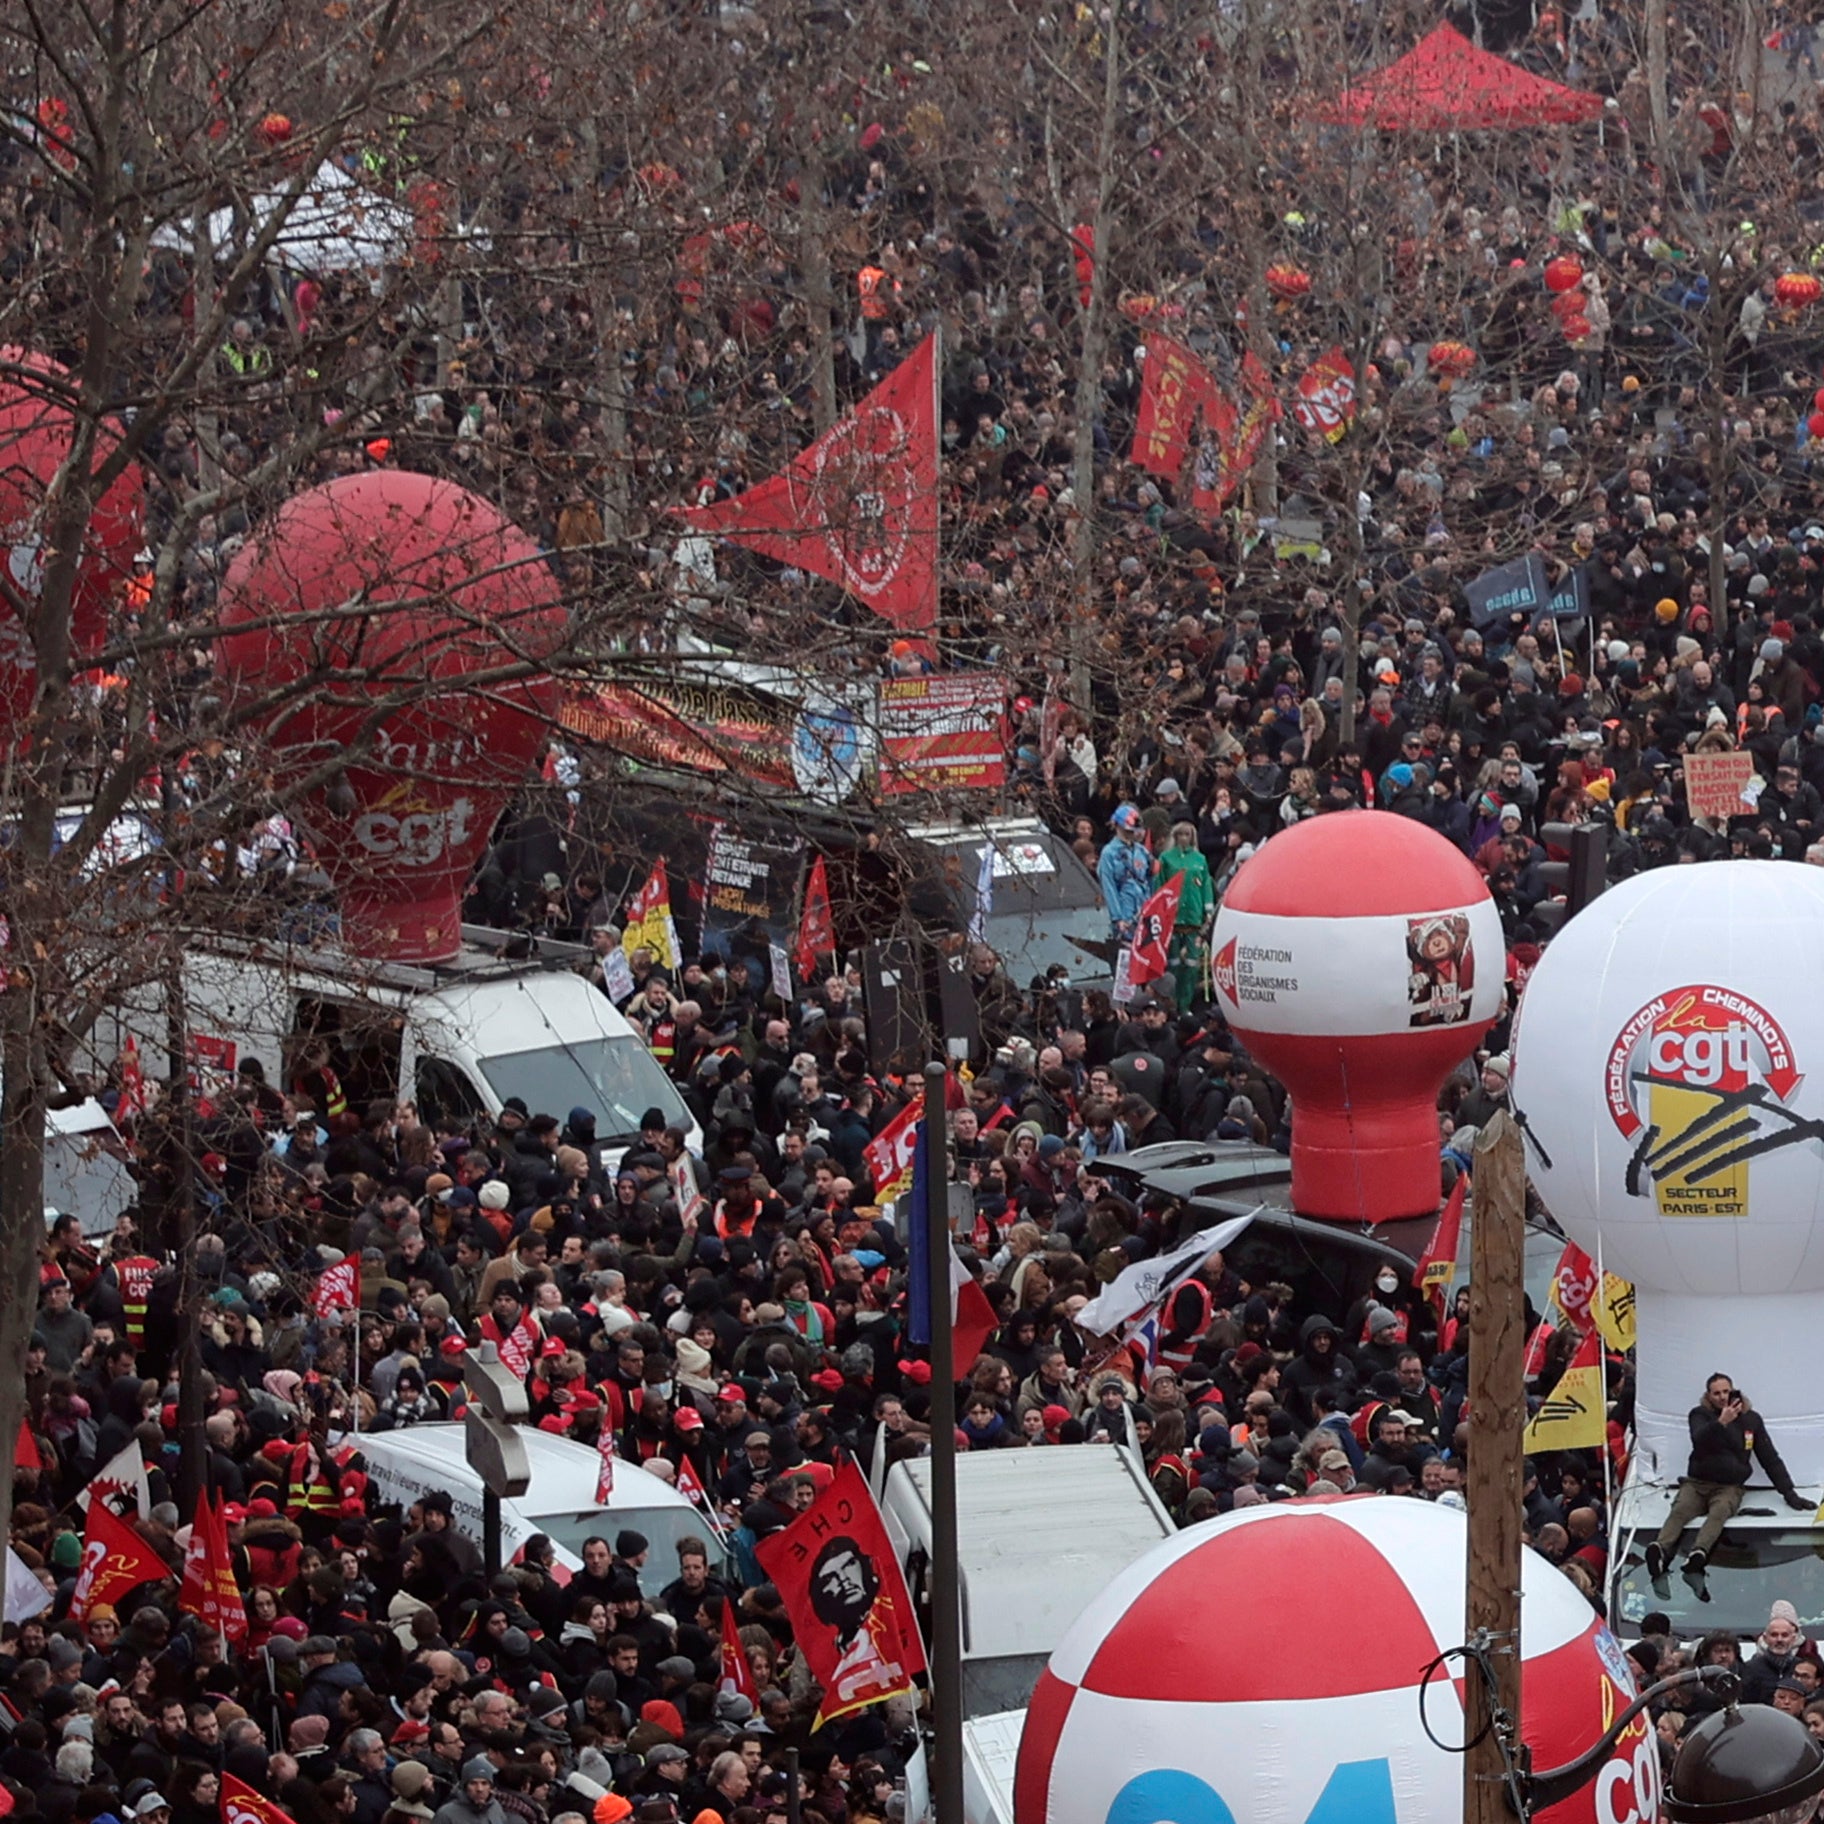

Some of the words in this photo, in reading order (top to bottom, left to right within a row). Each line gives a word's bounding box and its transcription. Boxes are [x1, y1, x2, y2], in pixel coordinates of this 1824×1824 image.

[354, 795, 472, 867] cgt
[1237, 946, 1293, 964] FÉDÉRATION
[1237, 960, 1254, 974] DES
[1237, 976, 1299, 992] ORGANISMES
[1239, 989, 1277, 1004] SOCIAUX
[1656, 995, 1747, 1032] la
[1608, 999, 1668, 1118] FÉDÉRATION
[1703, 989, 1789, 1072] CHEMINOTS
[1649, 1020, 1751, 1086] cgt
[1665, 1188, 1738, 1200] SECTEUR
